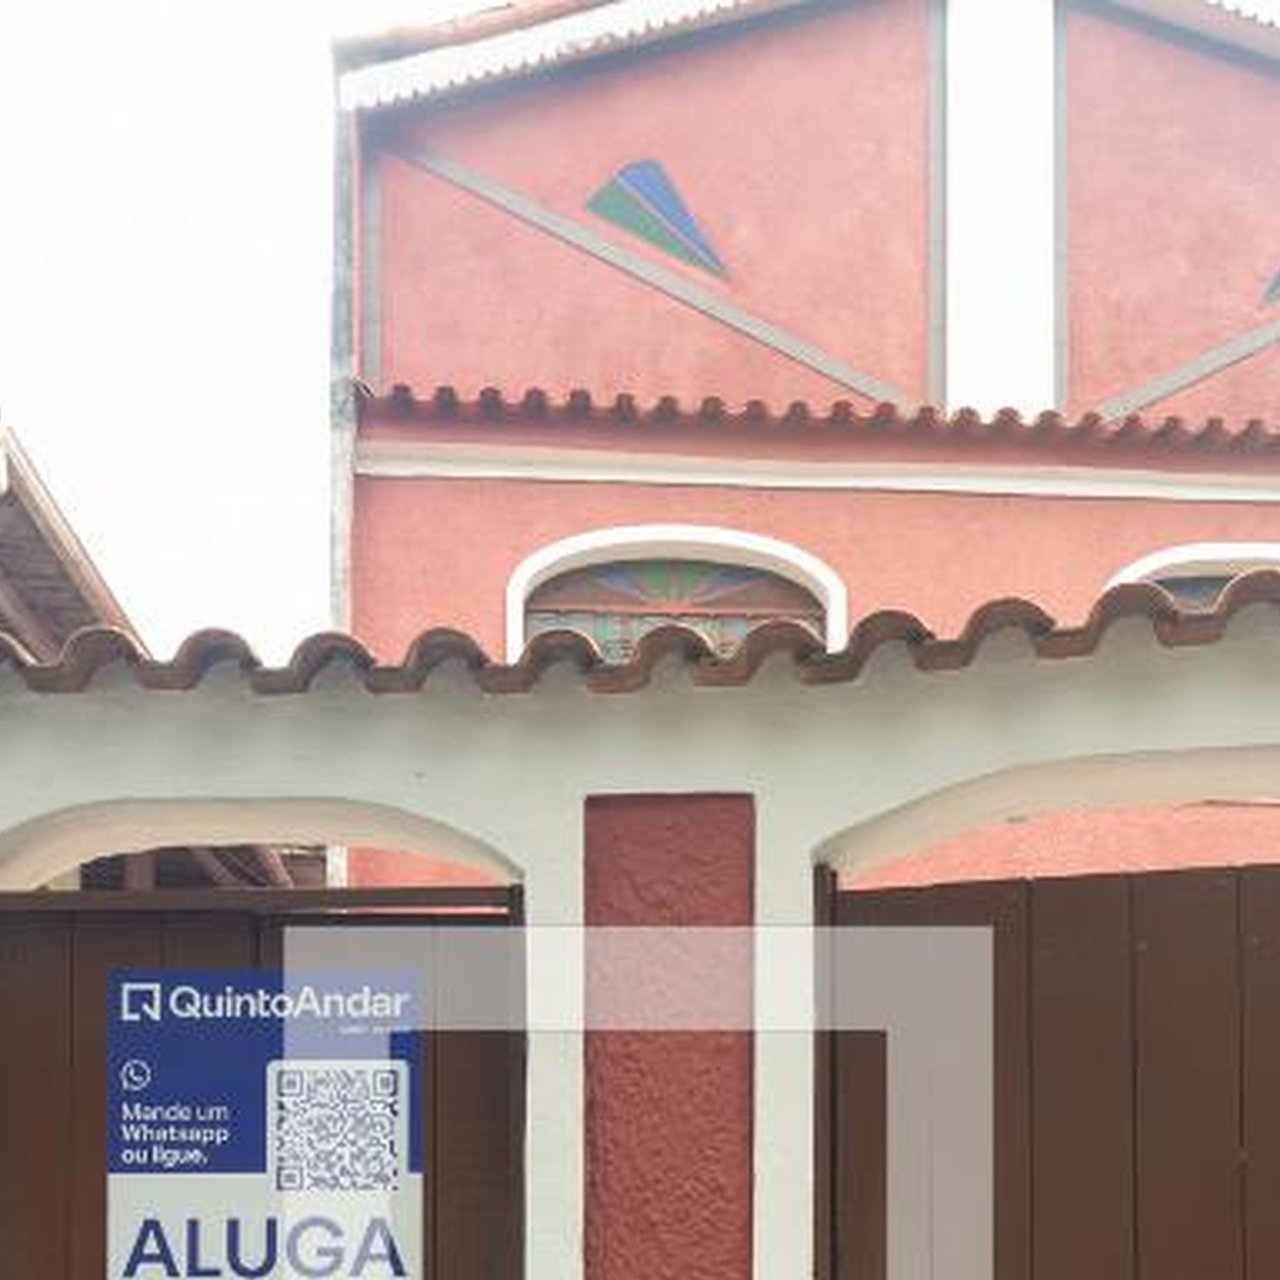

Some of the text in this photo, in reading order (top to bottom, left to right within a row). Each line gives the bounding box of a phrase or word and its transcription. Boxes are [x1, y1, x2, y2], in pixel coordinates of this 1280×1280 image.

[170, 985, 412, 1019] QuintoAndar
[122, 1102, 228, 1121] Mande um
[121, 1124, 229, 1146] Whatsapp
[121, 1145, 209, 1169] ou ligue.
[122, 1217, 408, 1279] ALUGA
